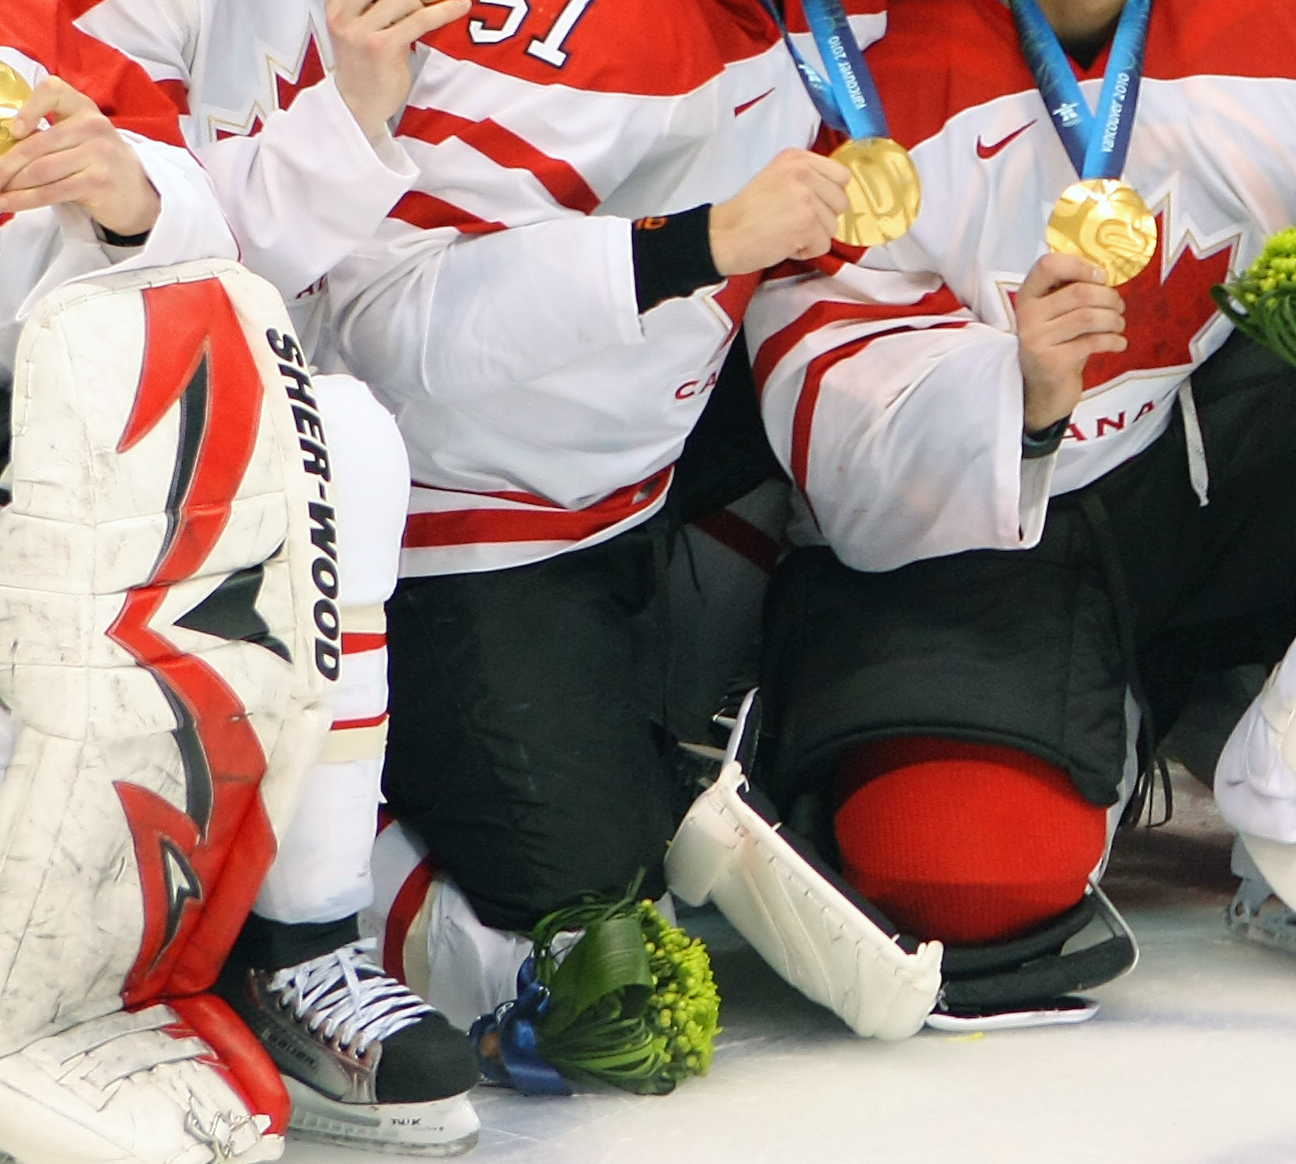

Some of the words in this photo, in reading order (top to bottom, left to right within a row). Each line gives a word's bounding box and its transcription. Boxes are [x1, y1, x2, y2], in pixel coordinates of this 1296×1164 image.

[828, 36, 849, 62] 2010
[837, 62, 867, 110] vancouver
[1112, 72, 1130, 100] 2010
[1101, 99, 1124, 152] vancouver
[266, 327, 340, 682] SHER-WOOD
